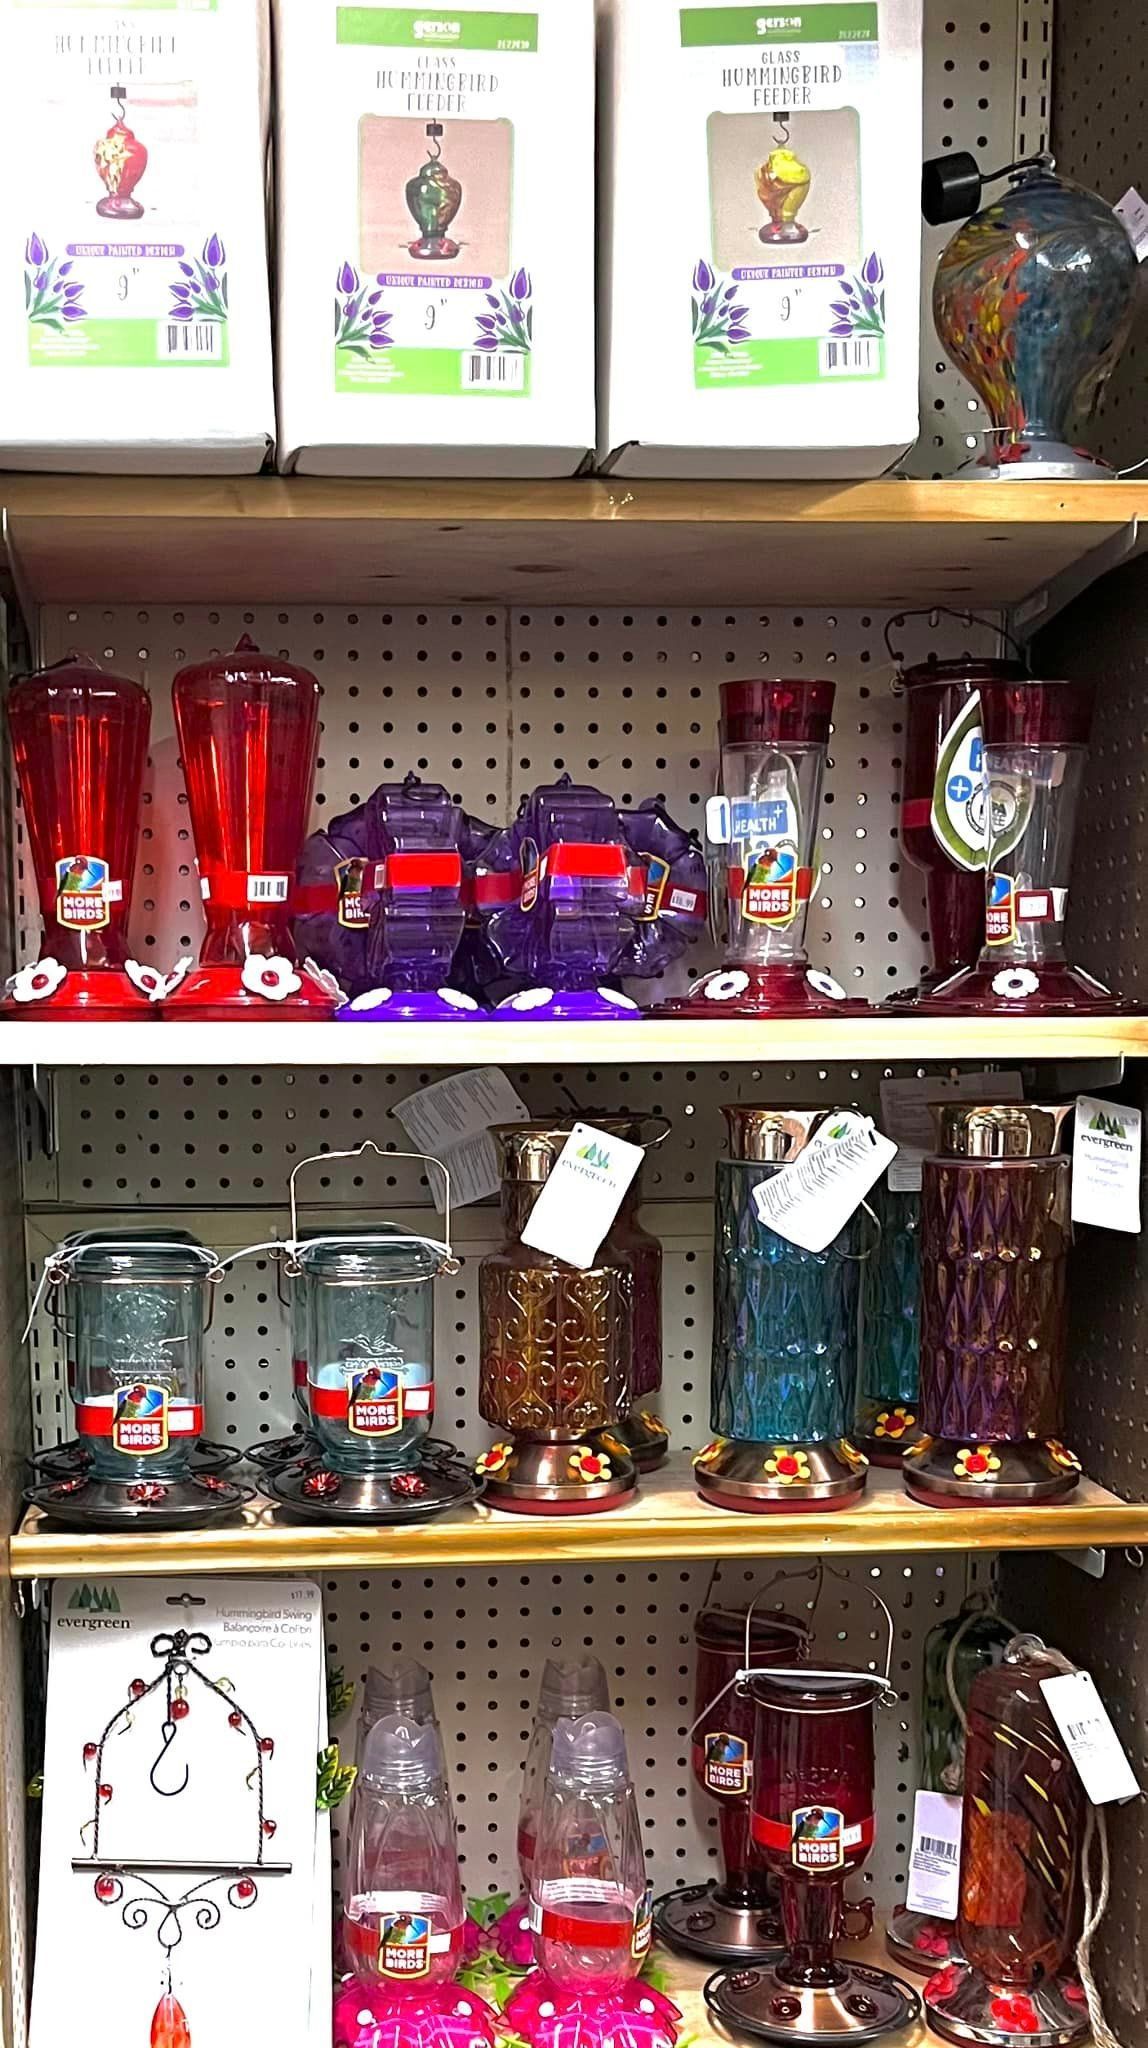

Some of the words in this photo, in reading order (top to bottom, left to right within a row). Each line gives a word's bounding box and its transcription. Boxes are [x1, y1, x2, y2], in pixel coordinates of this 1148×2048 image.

[756, 17, 801, 35] gerson
[761, 50, 801, 64] GLASS
[376, 70, 499, 93] HUMMINGBIRD
[722, 64, 842, 87] HUMMINGBIRD
[753, 86, 811, 106] FEEDER
[749, 889, 790, 900] MORE
[63, 896, 103, 908] MORE
[345, 897, 361, 908] MO
[749, 900, 790, 912] BIRDS
[63, 908, 104, 919] BIRDS
[987, 912, 1009, 923] ORE
[1080, 1134, 1133, 1152] evergreen
[355, 1405, 395, 1415] MORE
[355, 1415, 396, 1426] BIRDS
[120, 1423, 160, 1434] MORE
[120, 1434, 161, 1445] BIRDS
[216, 1607, 281, 1621] Hummingbird
[283, 1608, 312, 1622] Swing
[57, 1617, 130, 1631] evergreen
[709, 1764, 741, 1778] MORE
[709, 1774, 741, 1787] BIRDS
[798, 1842, 837, 1853] MORE
[798, 1853, 838, 1863] BIRDS
[385, 1947, 425, 1959] MORE
[385, 1958, 424, 1969] BIRDS
